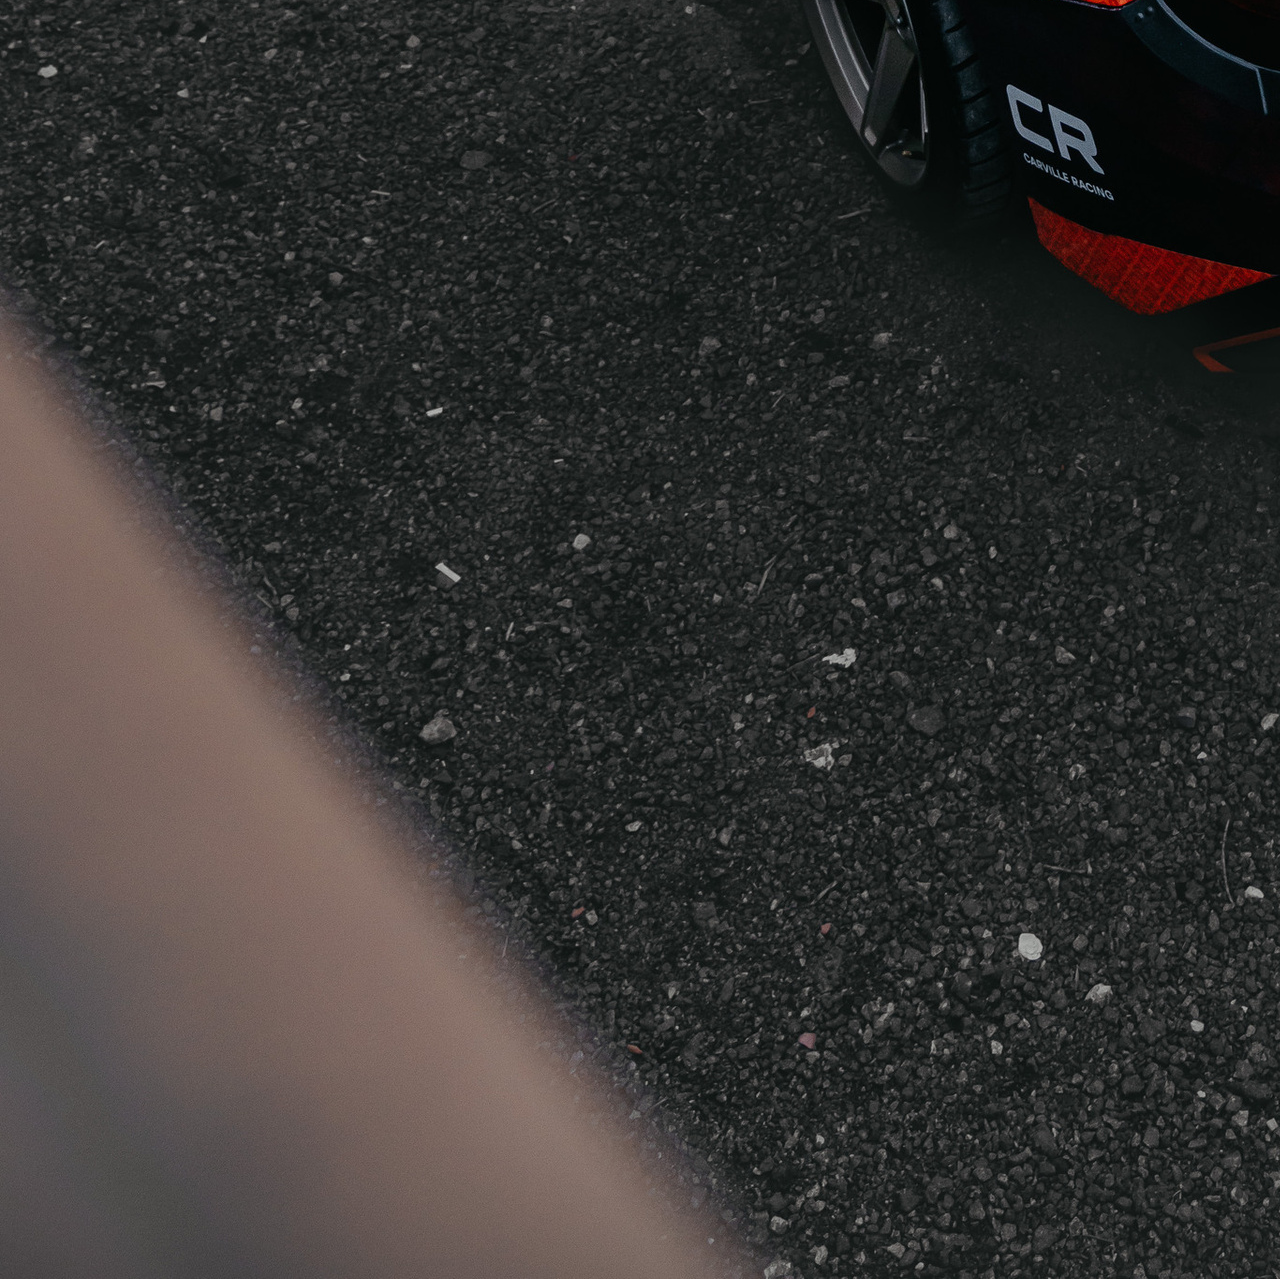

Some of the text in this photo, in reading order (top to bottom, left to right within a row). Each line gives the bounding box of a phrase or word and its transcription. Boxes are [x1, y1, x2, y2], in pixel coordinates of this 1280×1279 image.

[1005, 83, 1106, 176] CR
[1023, 152, 1115, 201] CARVILLE RACING
